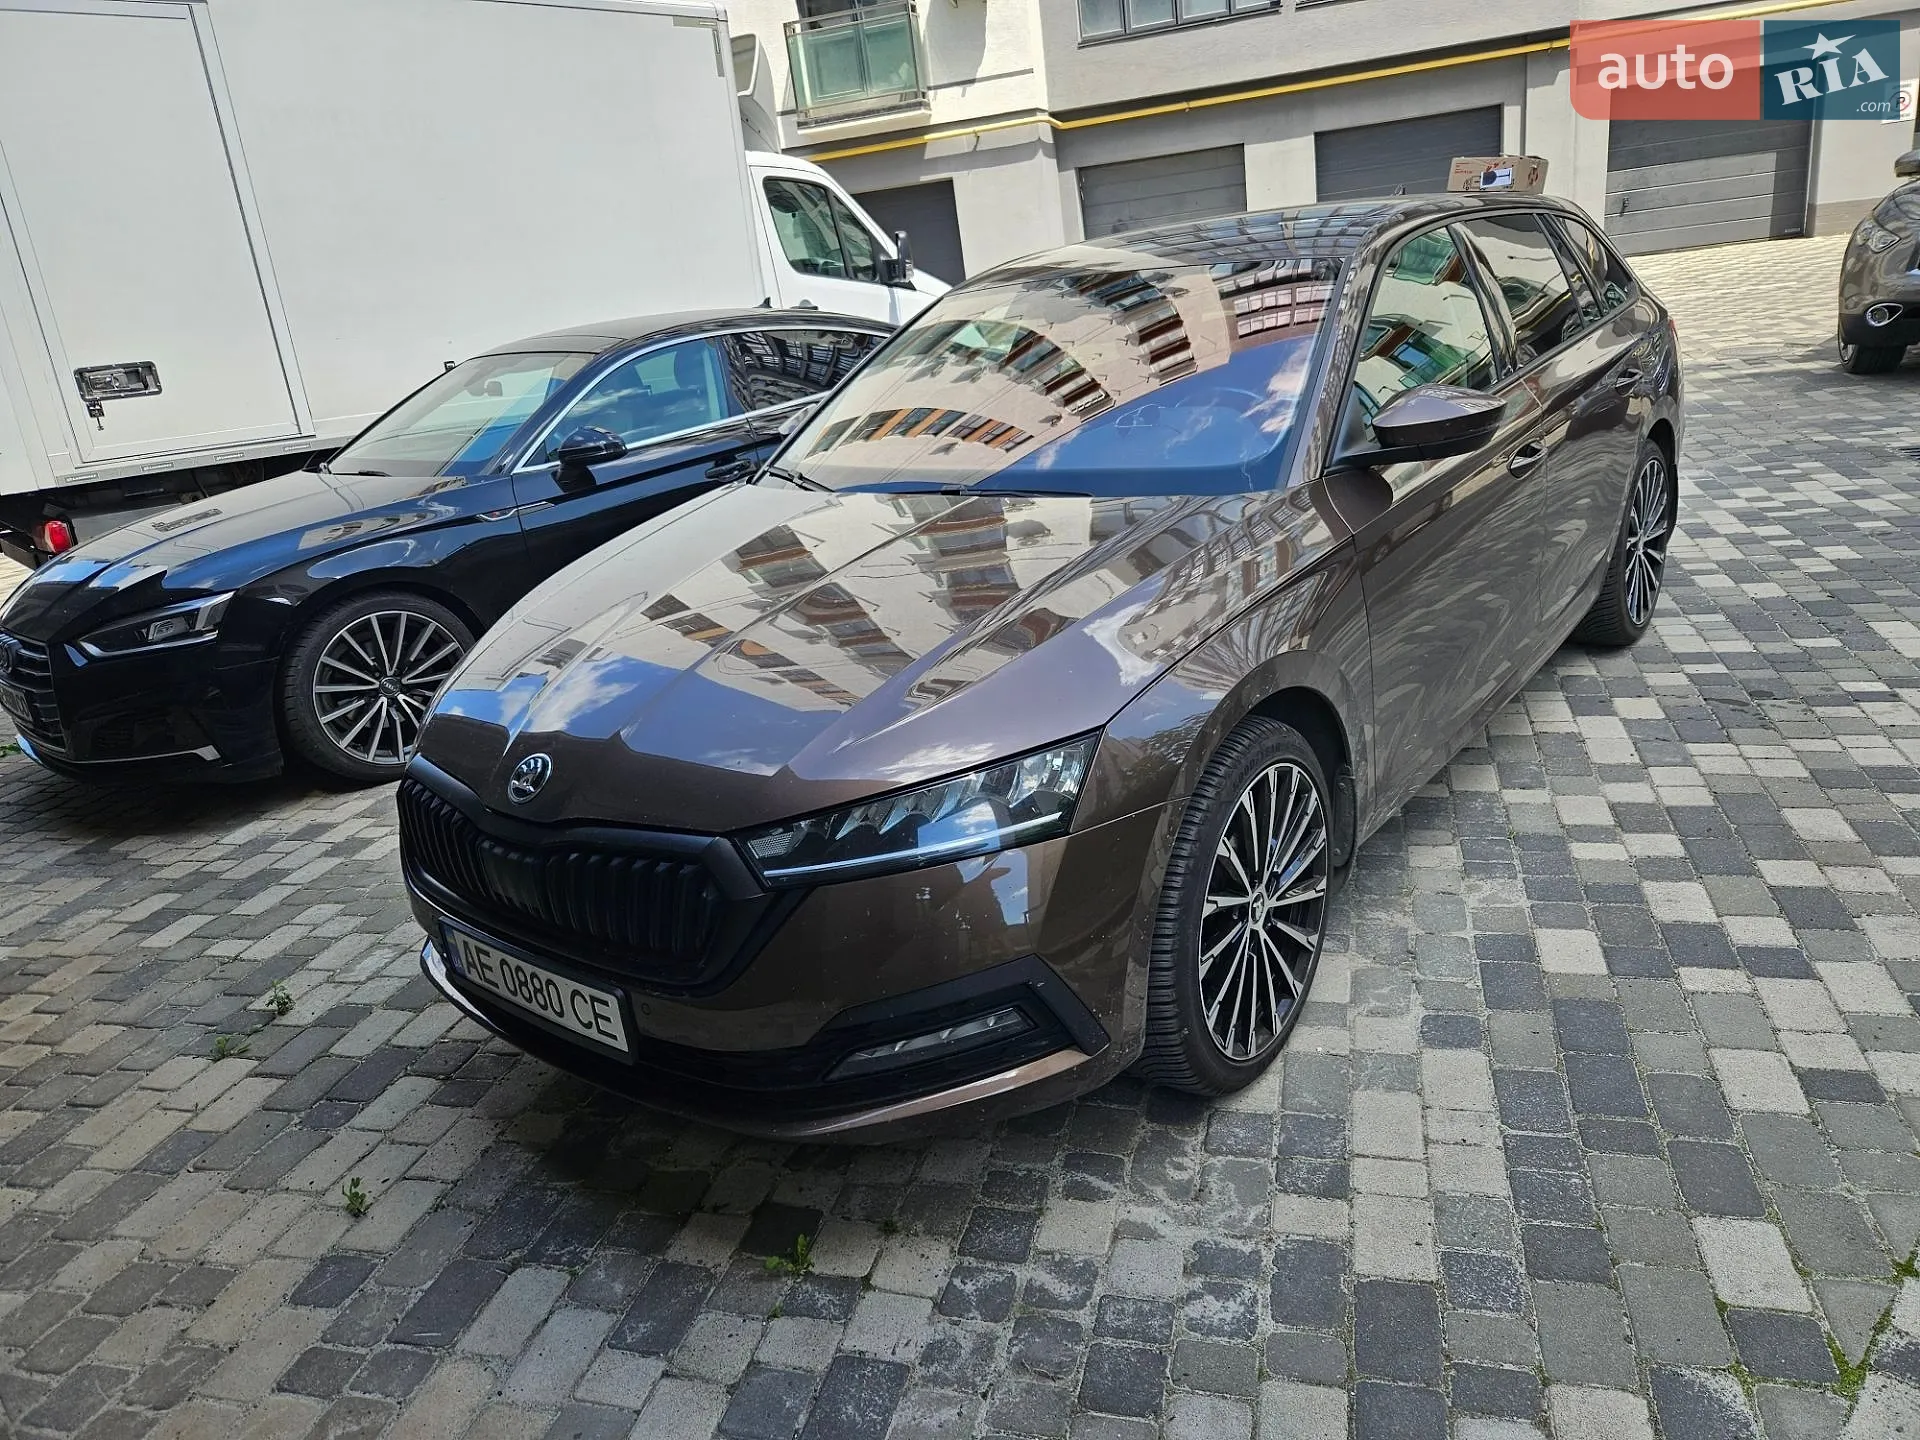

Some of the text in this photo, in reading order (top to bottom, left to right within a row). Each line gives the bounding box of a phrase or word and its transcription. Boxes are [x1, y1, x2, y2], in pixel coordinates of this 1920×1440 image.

[463, 939, 618, 1041] AE 0880 CE
